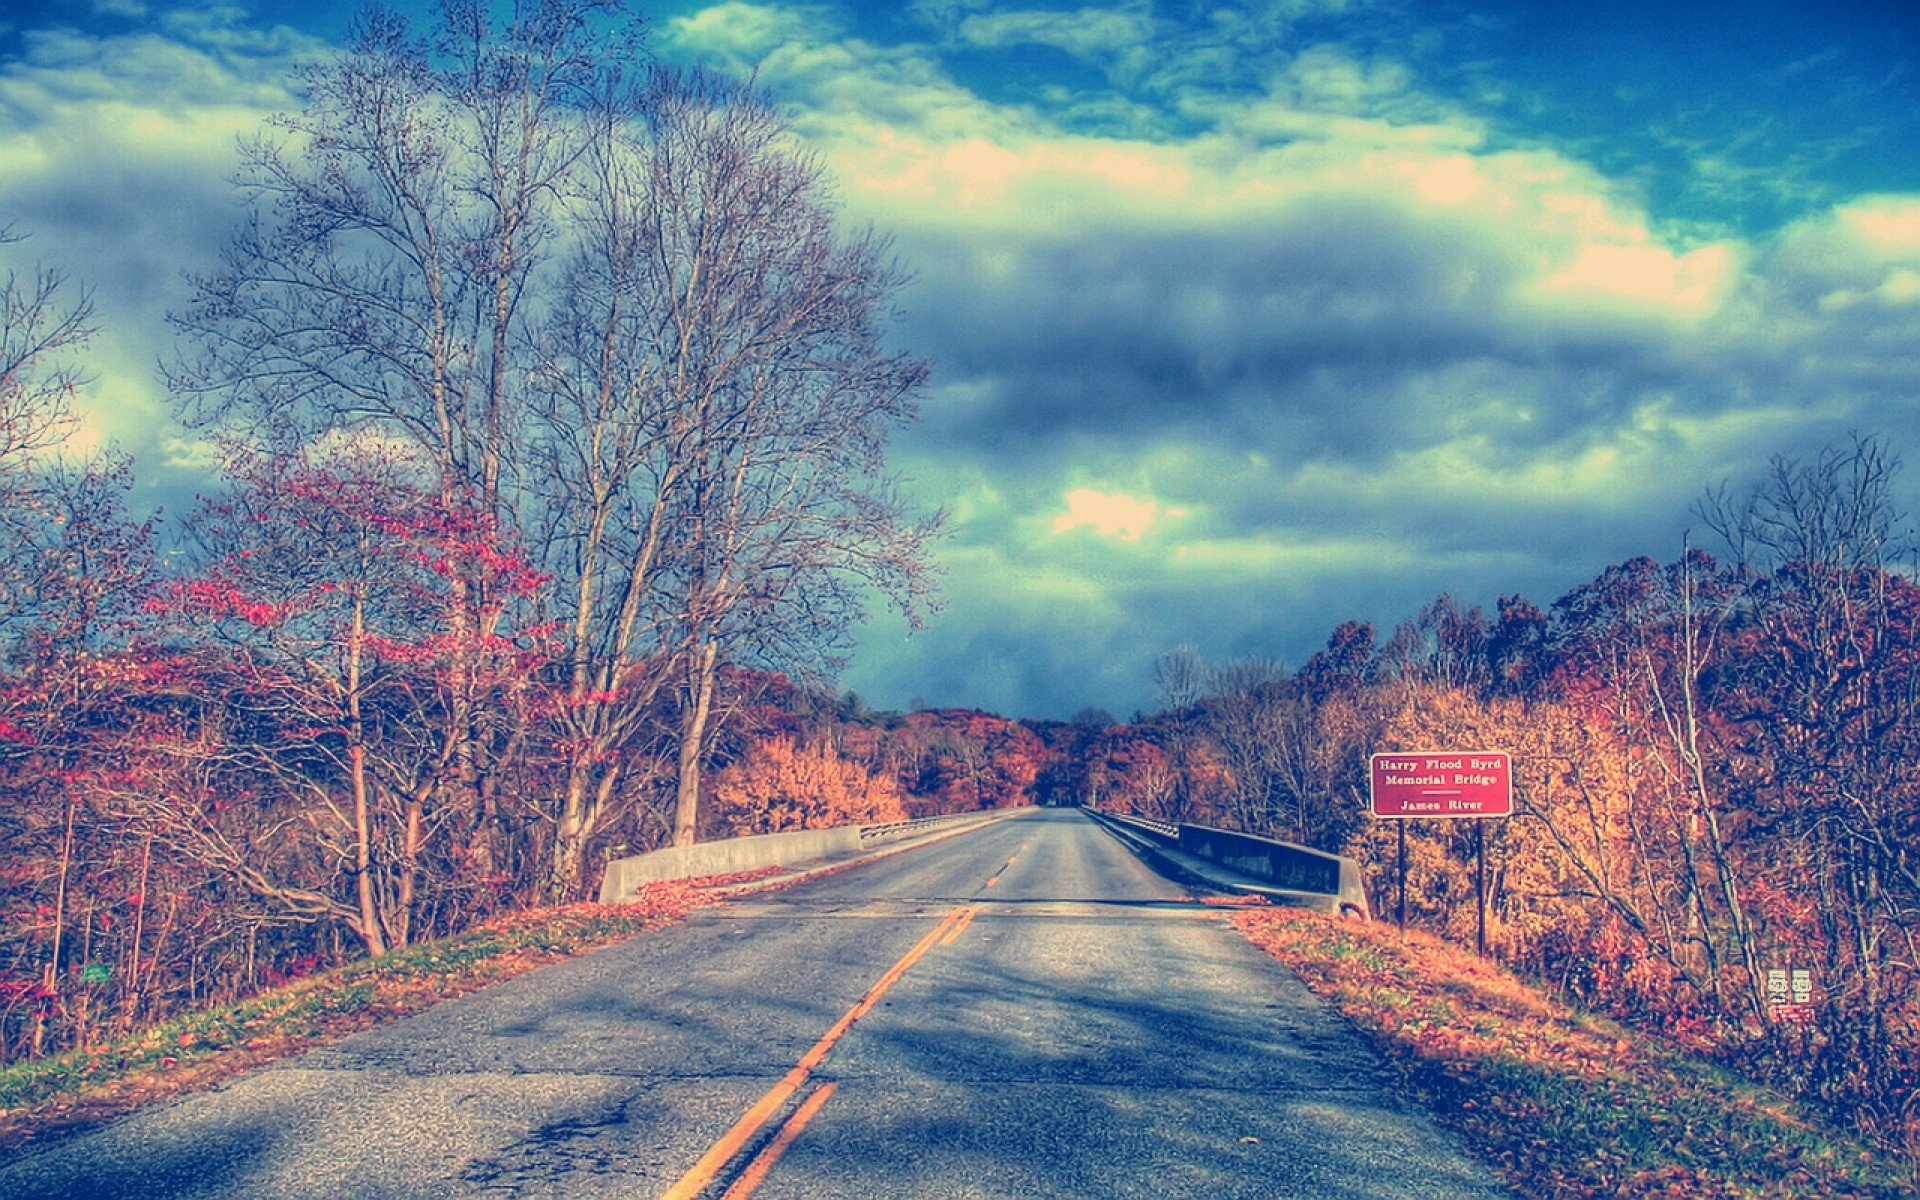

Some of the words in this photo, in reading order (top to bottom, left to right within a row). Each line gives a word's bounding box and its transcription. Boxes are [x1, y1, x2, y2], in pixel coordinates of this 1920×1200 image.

[1380, 759, 1418, 772] Harry
[1426, 759, 1462, 770] Flood
[1471, 758, 1501, 771] Byrd
[1385, 774, 1446, 785] Memorial
[1454, 774, 1498, 786] Bridge
[1400, 800, 1441, 810] James
[1448, 800, 1483, 810] River
